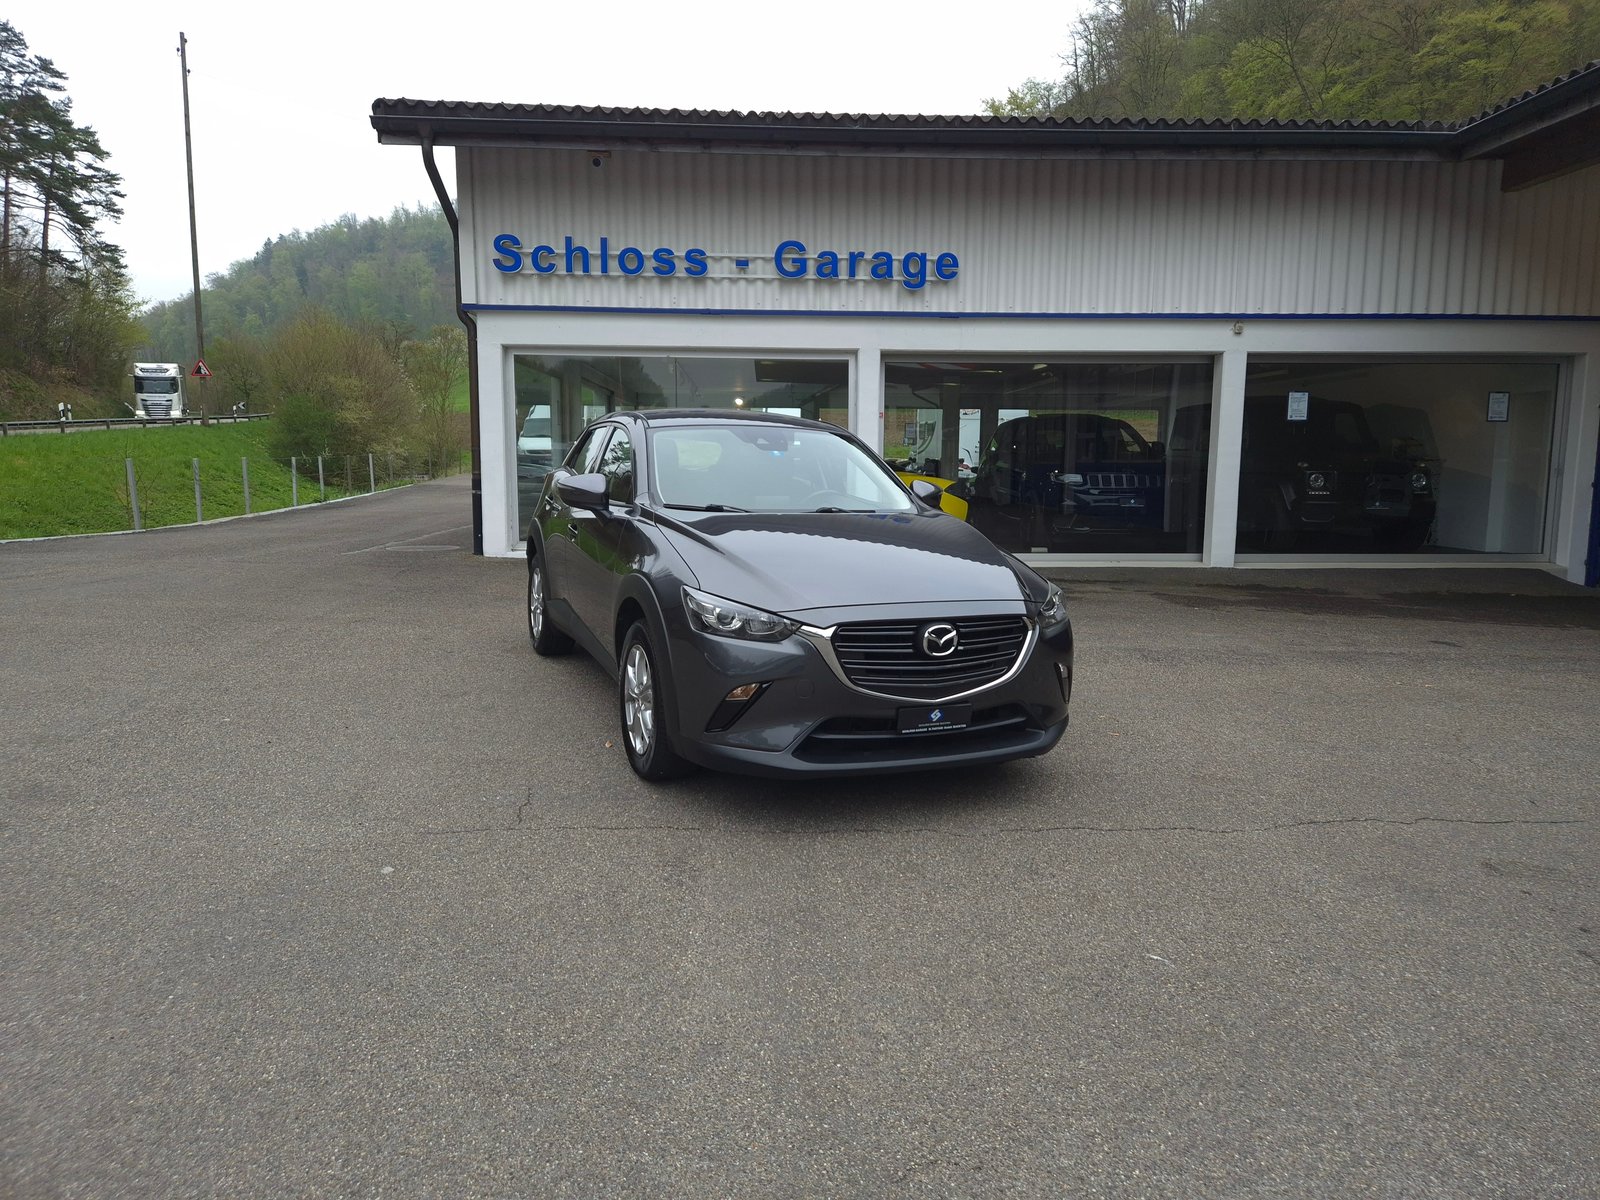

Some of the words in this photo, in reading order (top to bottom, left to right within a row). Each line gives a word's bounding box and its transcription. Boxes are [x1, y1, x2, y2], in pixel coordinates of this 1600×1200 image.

[493, 234, 708, 277] Schloss
[735, 259, 750, 268] -
[774, 240, 960, 290] Garage
